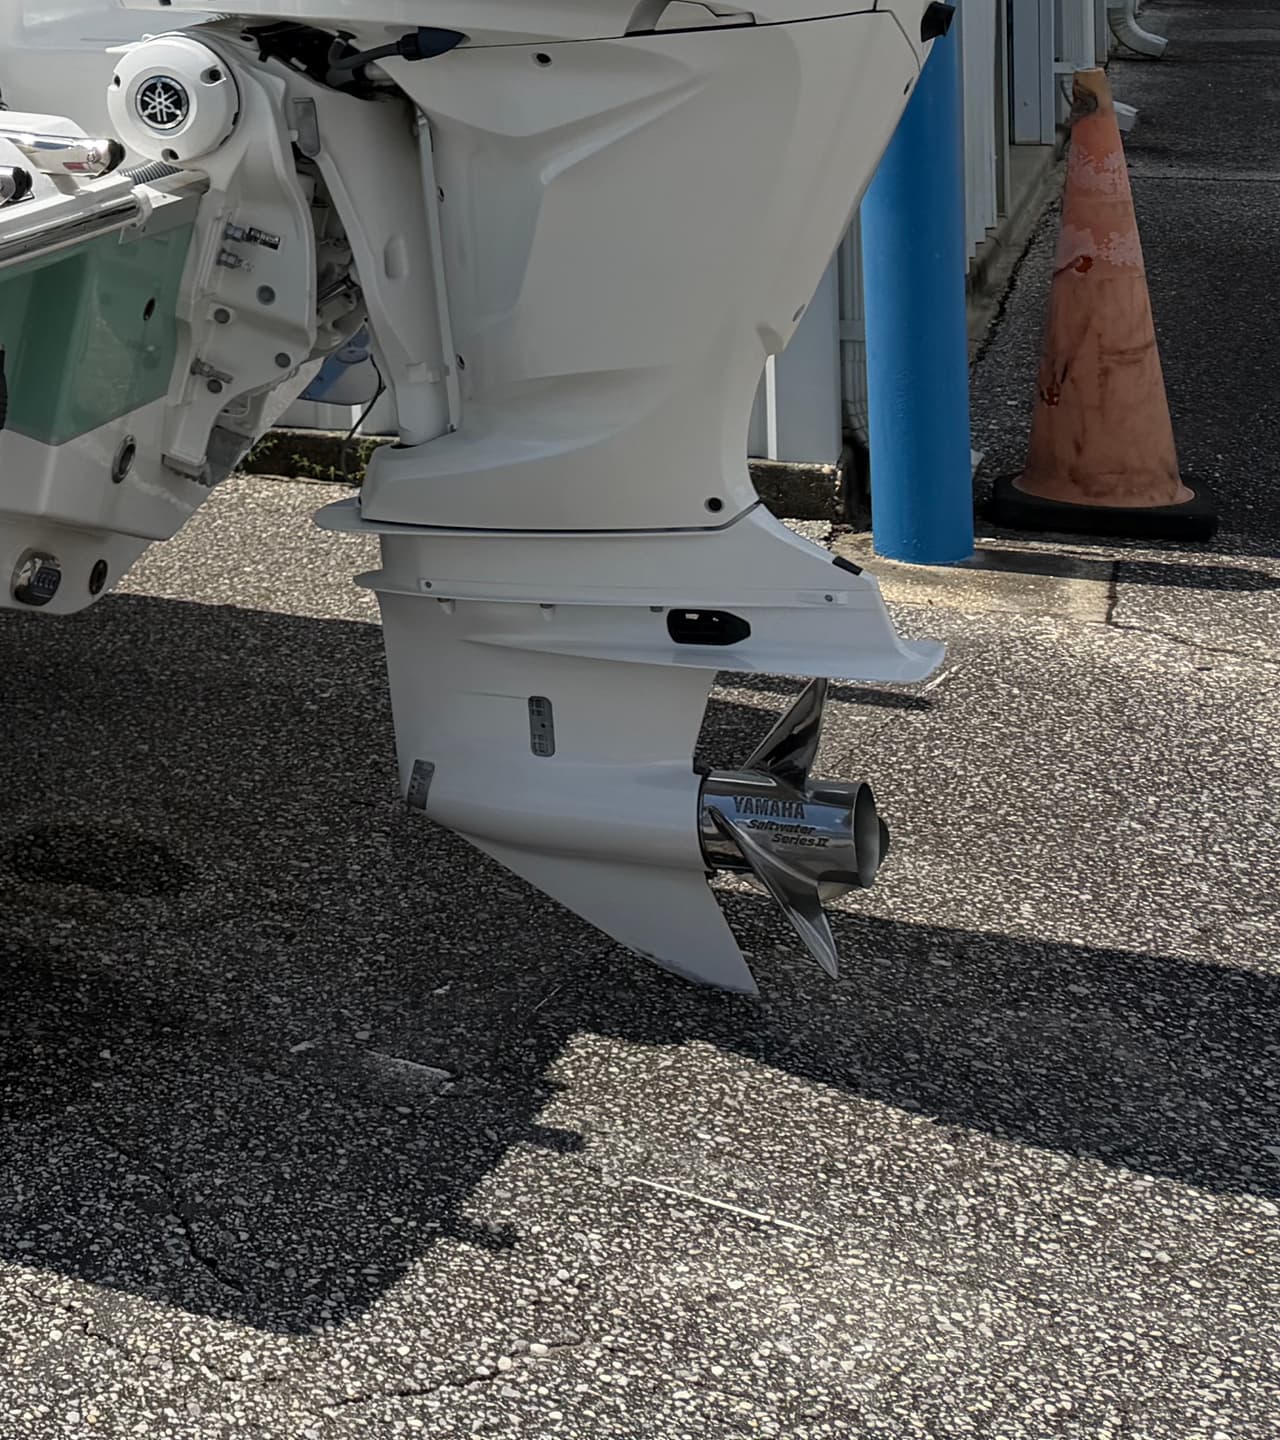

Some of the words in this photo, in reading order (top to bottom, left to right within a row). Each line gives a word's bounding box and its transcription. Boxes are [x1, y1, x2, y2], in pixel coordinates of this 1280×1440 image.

[733, 795, 805, 819] YAMAHA
[747, 819, 817, 834] Saltwater
[771, 833, 814, 847] Series
